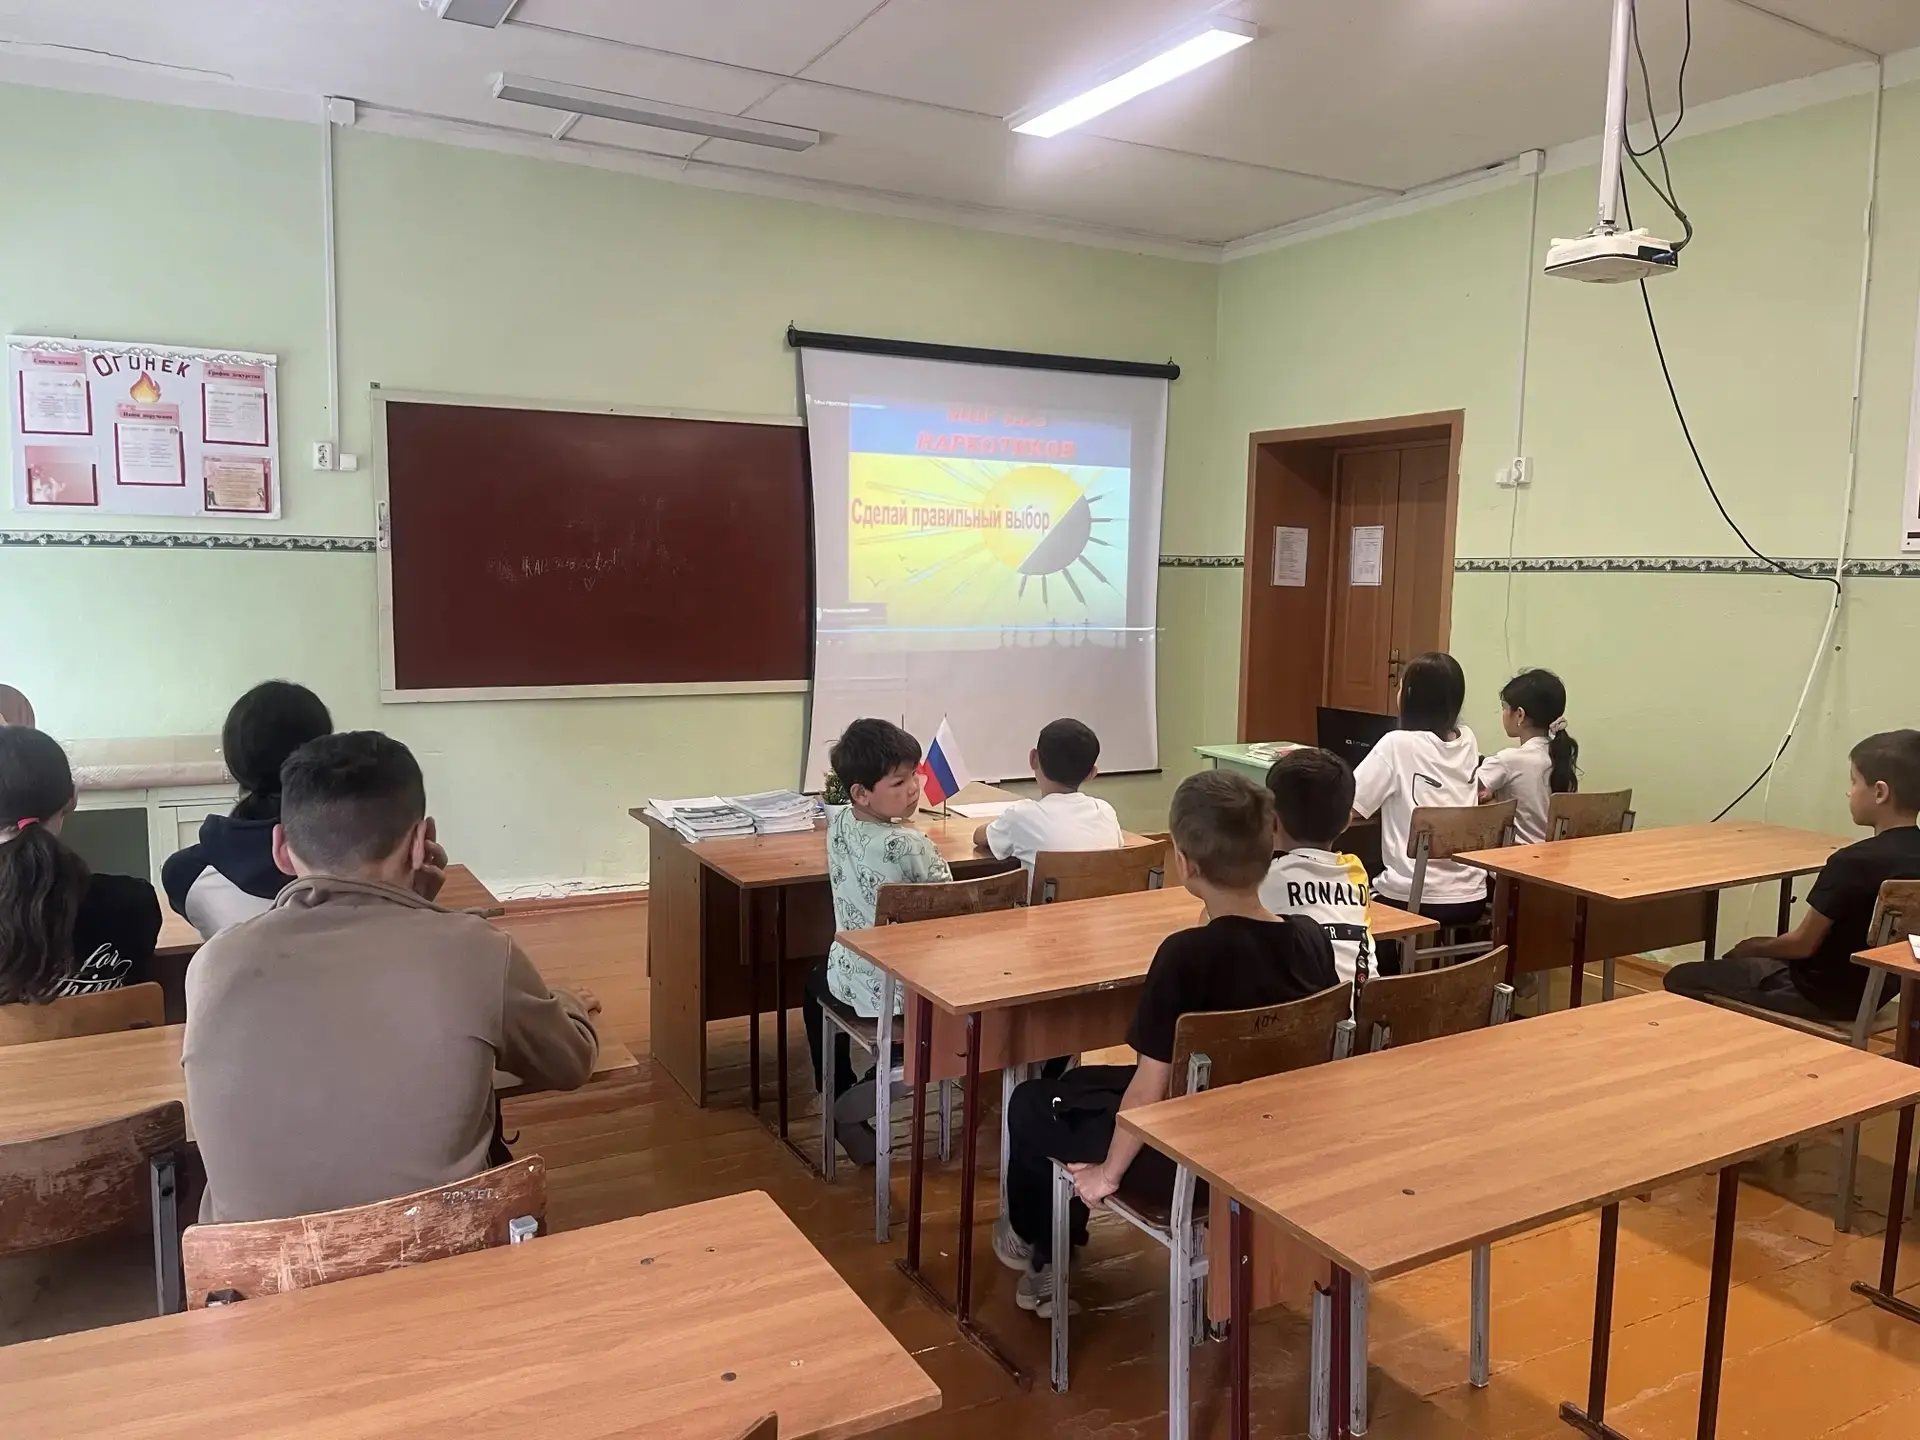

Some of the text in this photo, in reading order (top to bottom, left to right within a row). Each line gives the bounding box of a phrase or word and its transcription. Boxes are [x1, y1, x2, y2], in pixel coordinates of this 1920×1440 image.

[92, 354, 190, 378] ОГОНЕК
[916, 431, 1076, 459] НАРКОТИКОВ
[851, 498, 1050, 534] Сделай правильный выбор
[1287, 881, 1370, 908] RONALD
